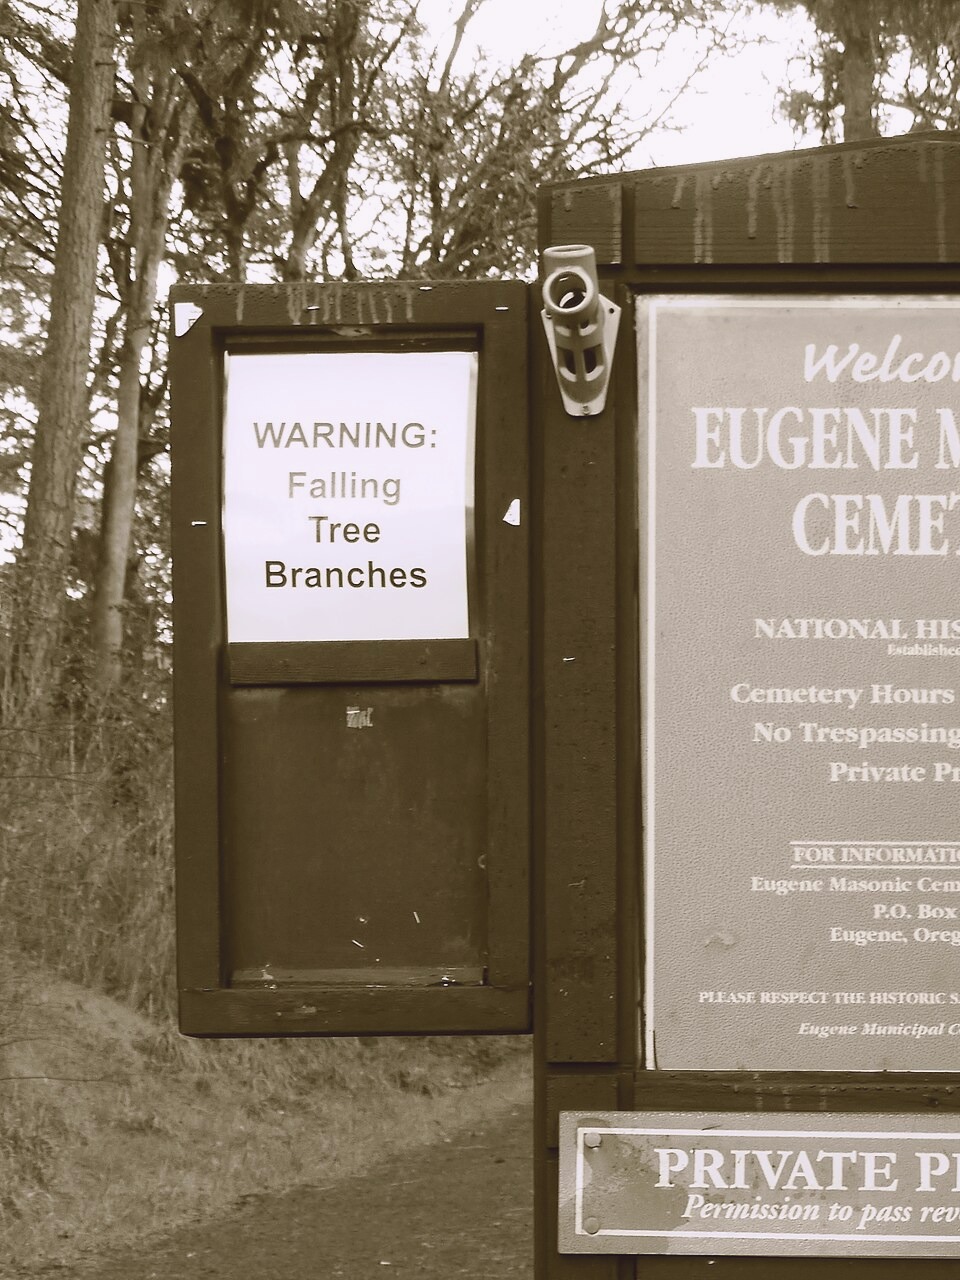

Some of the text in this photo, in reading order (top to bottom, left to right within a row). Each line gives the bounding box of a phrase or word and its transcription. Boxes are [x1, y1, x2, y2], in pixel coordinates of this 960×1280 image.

[252, 422, 438, 449] WARNING:
[690, 406, 919, 471] EUGENE
[288, 471, 402, 506] Falling
[308, 515, 382, 544] Tree
[264, 560, 428, 589] Branches
[753, 618, 908, 640] NATIONAL
[730, 683, 863, 709] Cemetery
[871, 684, 956, 706] Hours
[752, 722, 792, 744] No
[829, 762, 926, 784] Private
[793, 847, 836, 864] FOR
[750, 876, 824, 894] Eugene
[828, 877, 912, 893] Masonic
[872, 904, 912, 919] P.O.
[917, 904, 958, 919] Box
[829, 927, 908, 945] Eugene,
[699, 991, 756, 1003] PLEASE
[760, 992, 829, 1004] RESPECT
[832, 992, 867, 1004] THE
[870, 992, 946, 1004] HISTORIC
[798, 1023, 858, 1038] Eugene
[861, 1023, 945, 1039] Municipal
[654, 1148, 899, 1192] PRIVATE
[681, 1194, 820, 1220] Permission
[828, 1201, 853, 1221] to
[856, 1203, 913, 1230] pass
